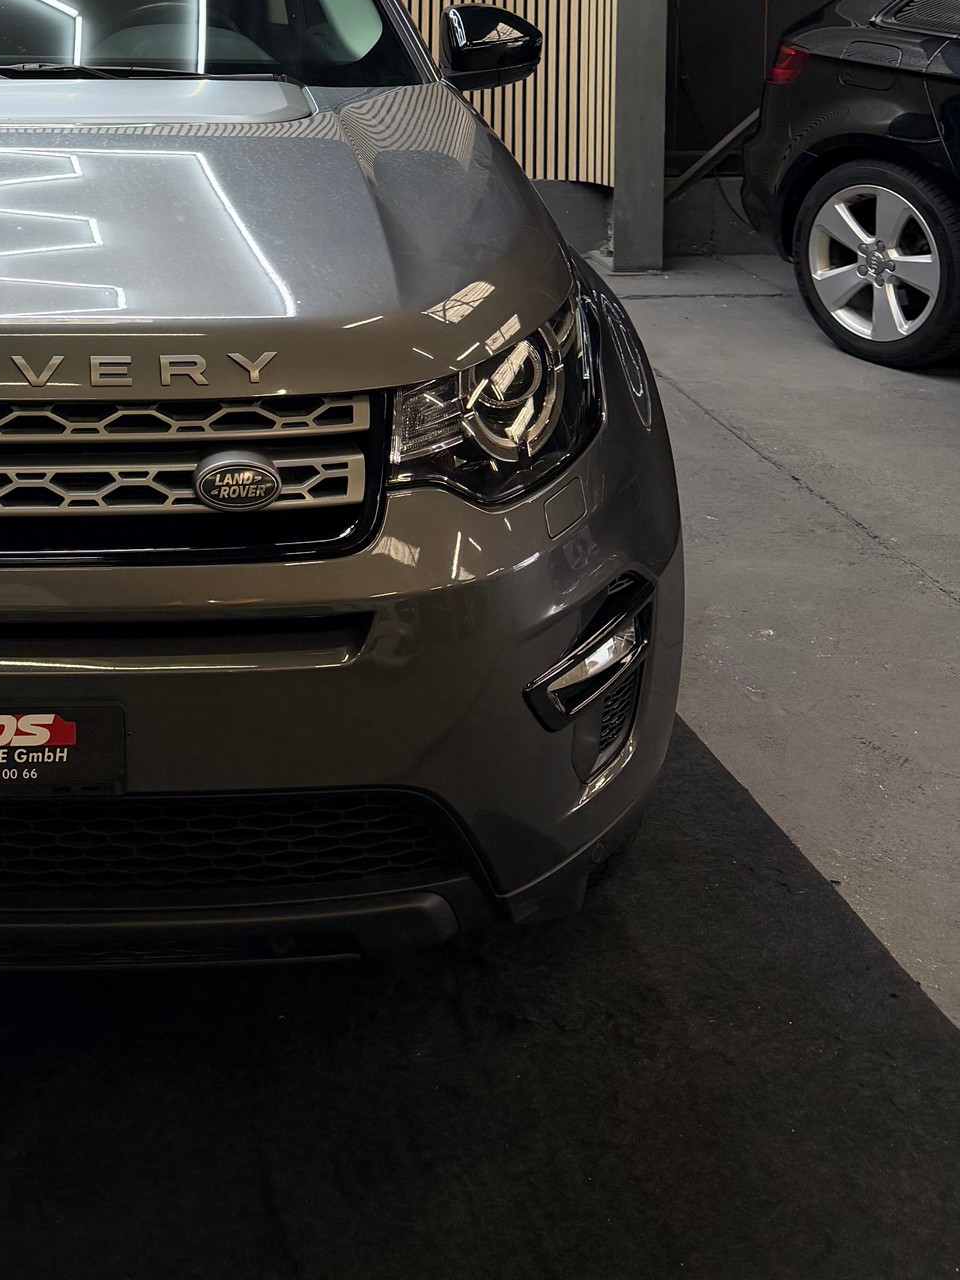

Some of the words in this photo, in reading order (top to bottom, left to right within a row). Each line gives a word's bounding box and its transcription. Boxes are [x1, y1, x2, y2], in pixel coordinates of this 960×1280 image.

[214, 471, 253, 486] LAND
[219, 484, 267, 499] ROVER
[14, 747, 69, 763] GmbH
[2, 768, 18, 780] 00
[22, 768, 38, 780] 66
